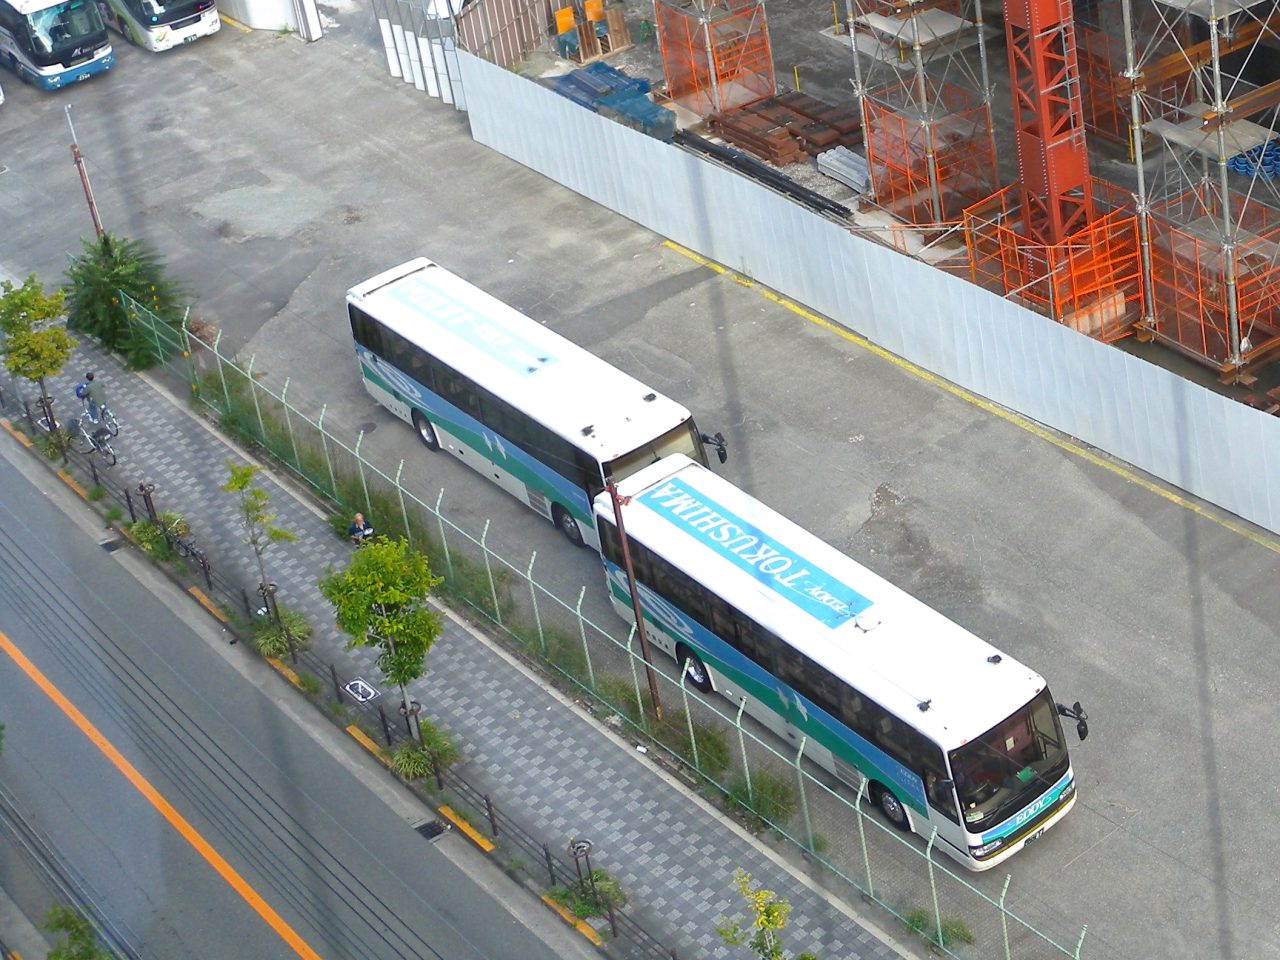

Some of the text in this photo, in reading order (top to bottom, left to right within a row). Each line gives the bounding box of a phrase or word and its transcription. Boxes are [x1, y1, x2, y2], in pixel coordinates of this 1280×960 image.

[650, 481, 810, 588] TOKUSHIMA
[808, 584, 850, 614] EDDY
[1014, 797, 1046, 825] EDDY
